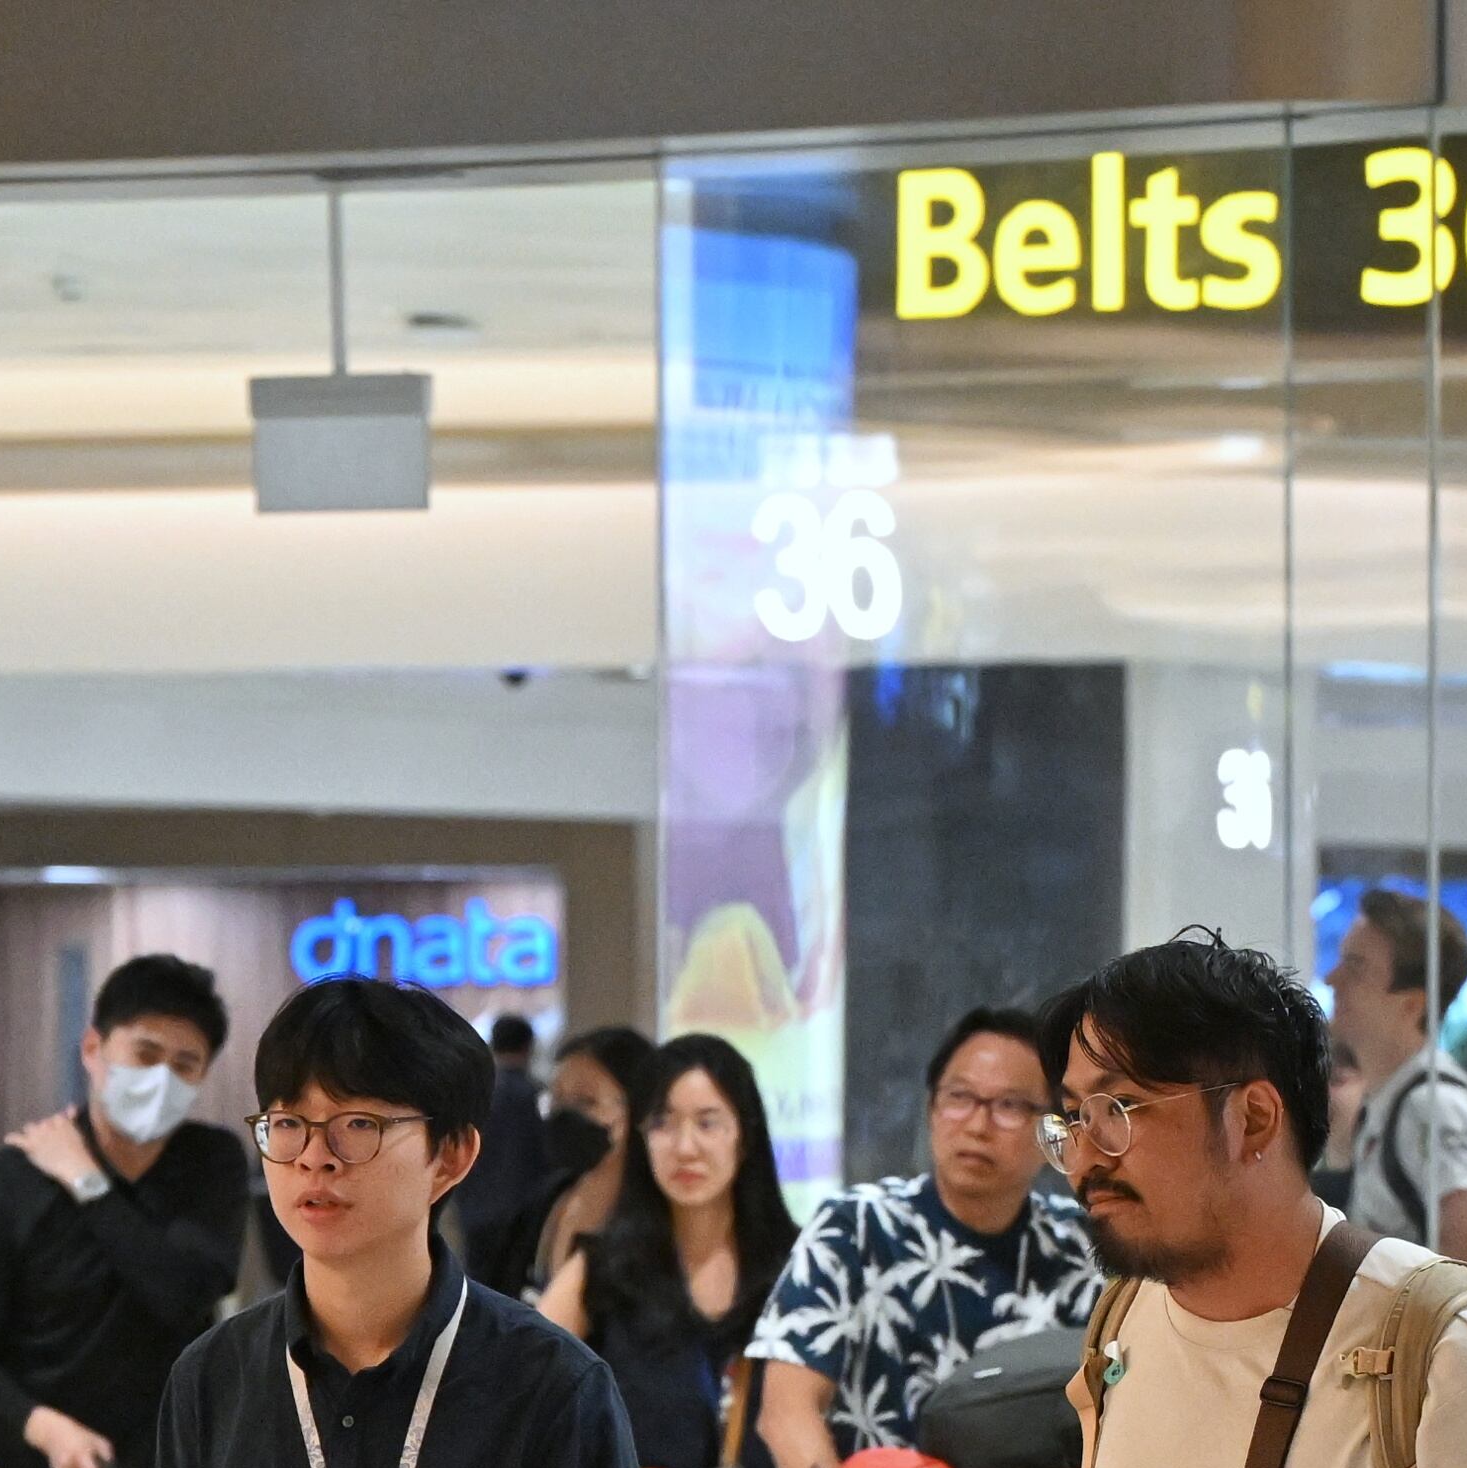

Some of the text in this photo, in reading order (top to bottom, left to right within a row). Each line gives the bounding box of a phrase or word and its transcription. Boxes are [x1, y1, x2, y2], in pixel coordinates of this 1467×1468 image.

[896, 151, 1282, 320] Belts
[751, 488, 903, 642] 36
[289, 896, 557, 989] dnata
